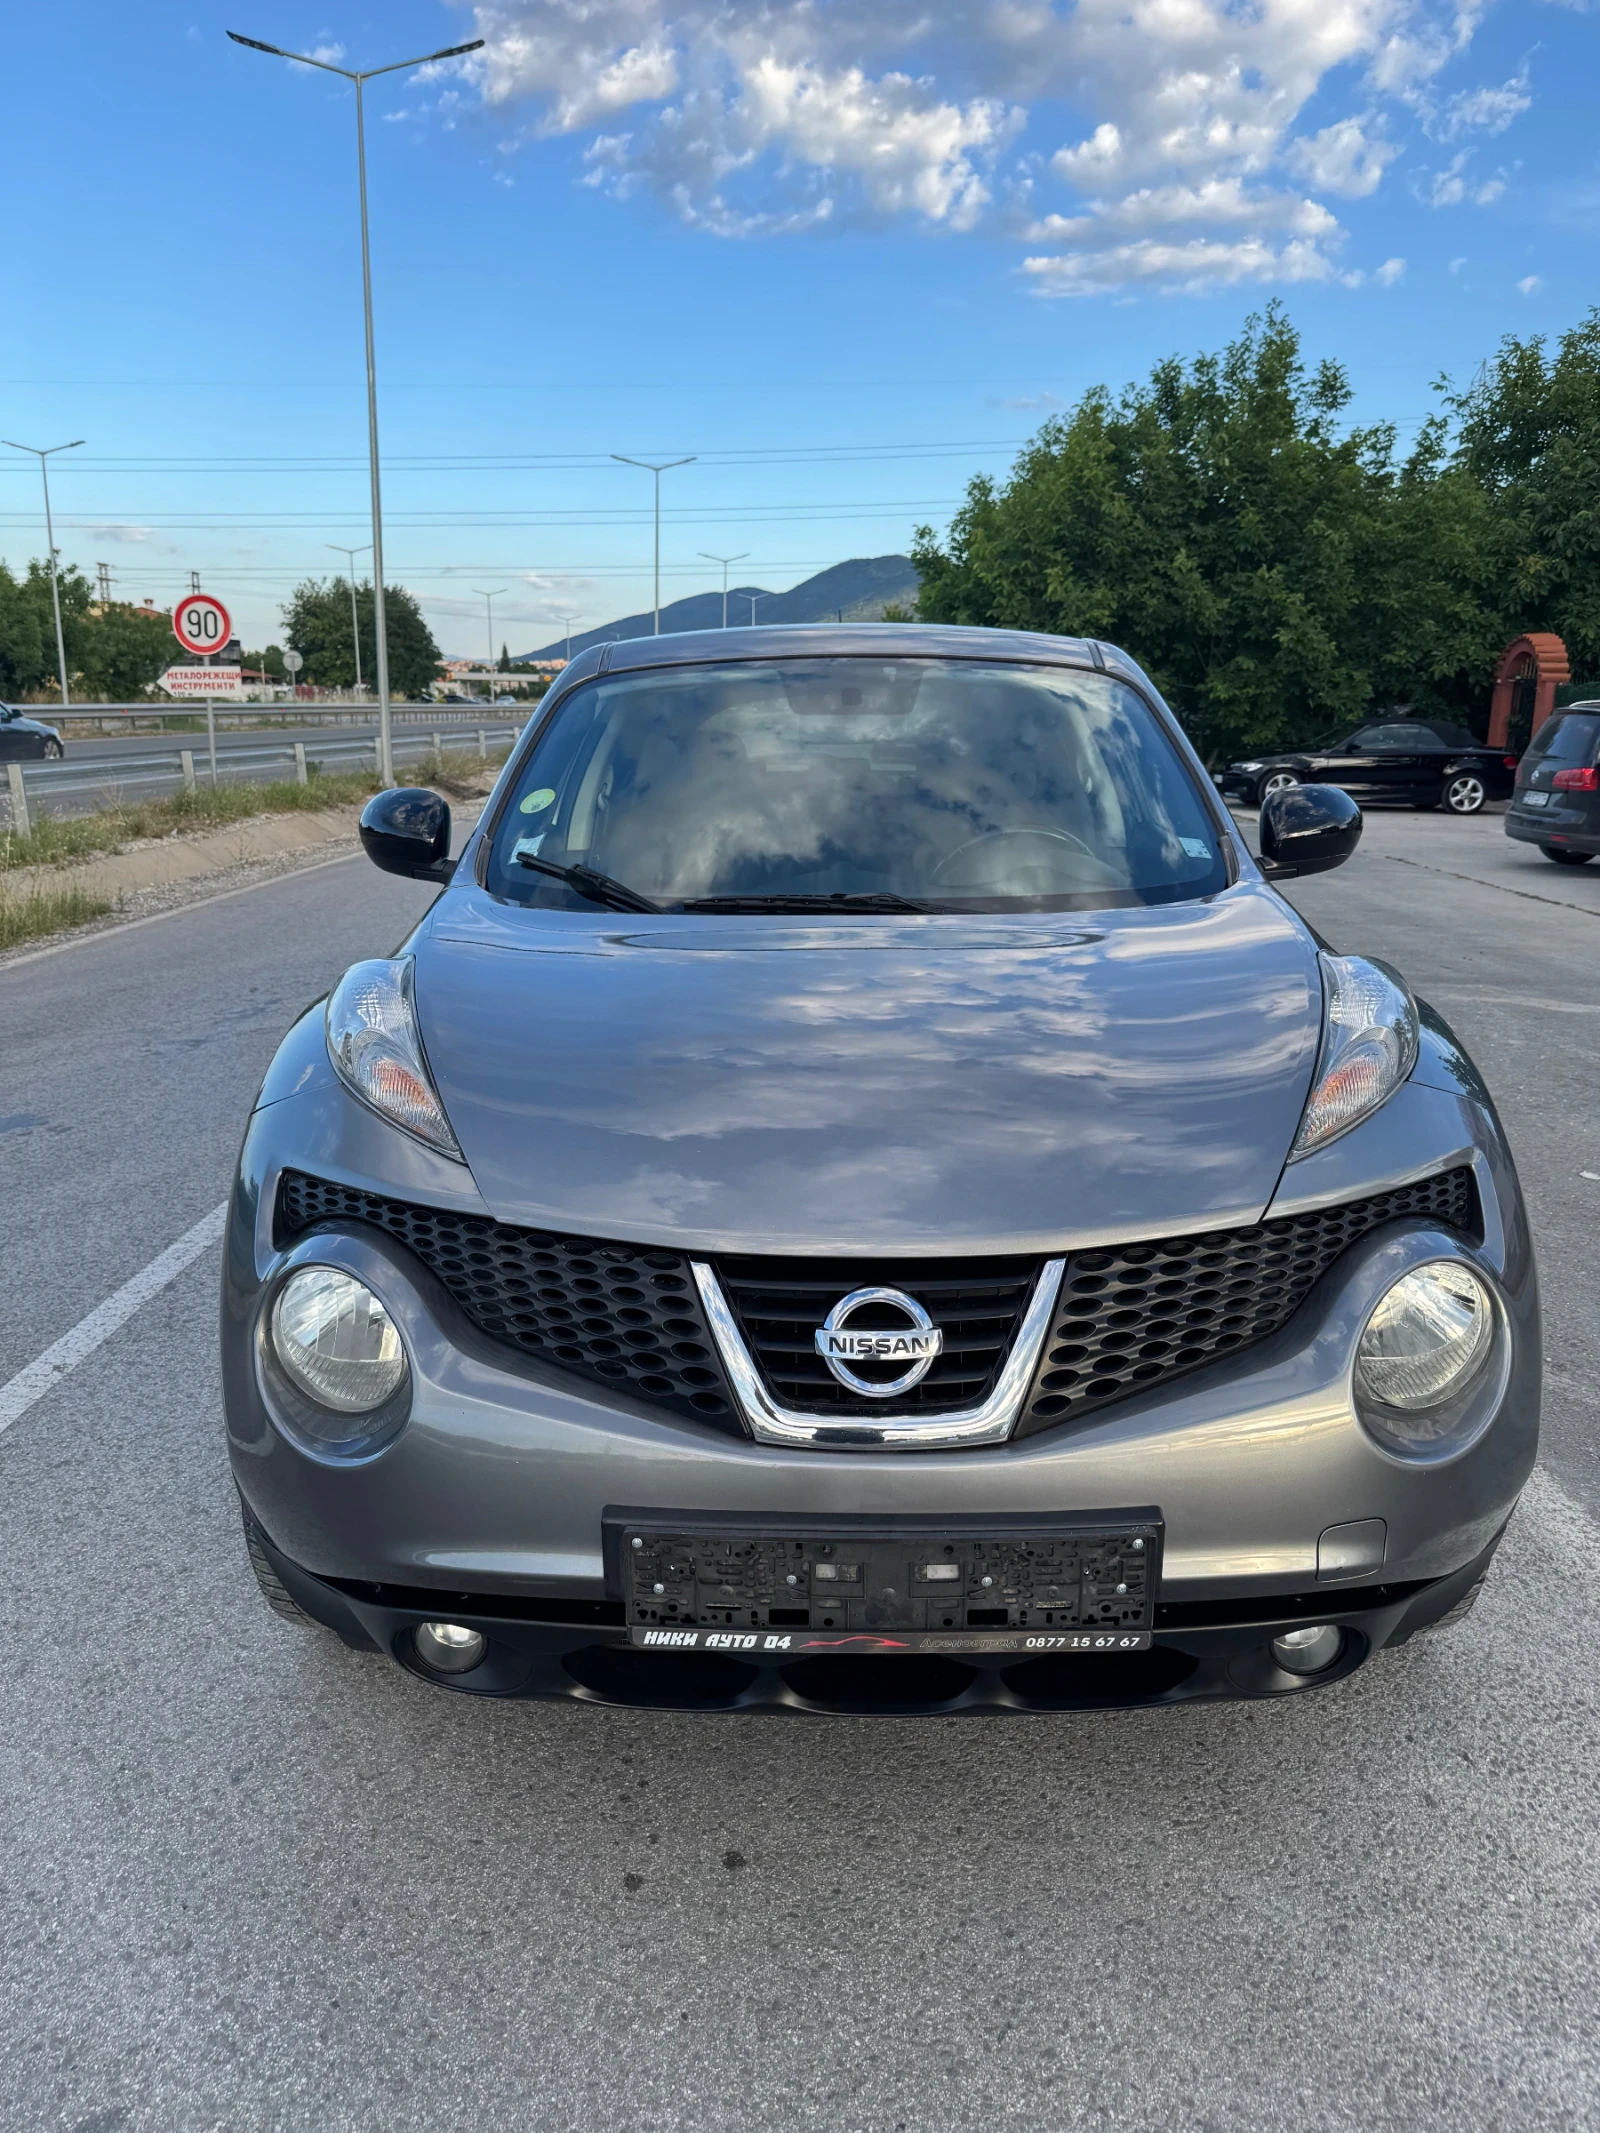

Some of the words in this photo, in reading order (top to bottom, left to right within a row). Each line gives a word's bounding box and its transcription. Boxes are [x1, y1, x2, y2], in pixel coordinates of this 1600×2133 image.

[188, 609, 218, 639] 90
[166, 671, 242, 681] МЕТАЛОРЕЖЕЩИ
[170, 682, 235, 691] ИНСТРУМЕНТИ
[828, 1336, 931, 1355] NISSAN
[643, 1631, 699, 1646] НИКИ
[705, 1632, 759, 1649] АУТО
[763, 1635, 792, 1650] 04
[1025, 1637, 1066, 1648] 0877
[1070, 1637, 1091, 1647] 15
[1095, 1637, 1115, 1647] 67
[1119, 1637, 1141, 1647] 67
